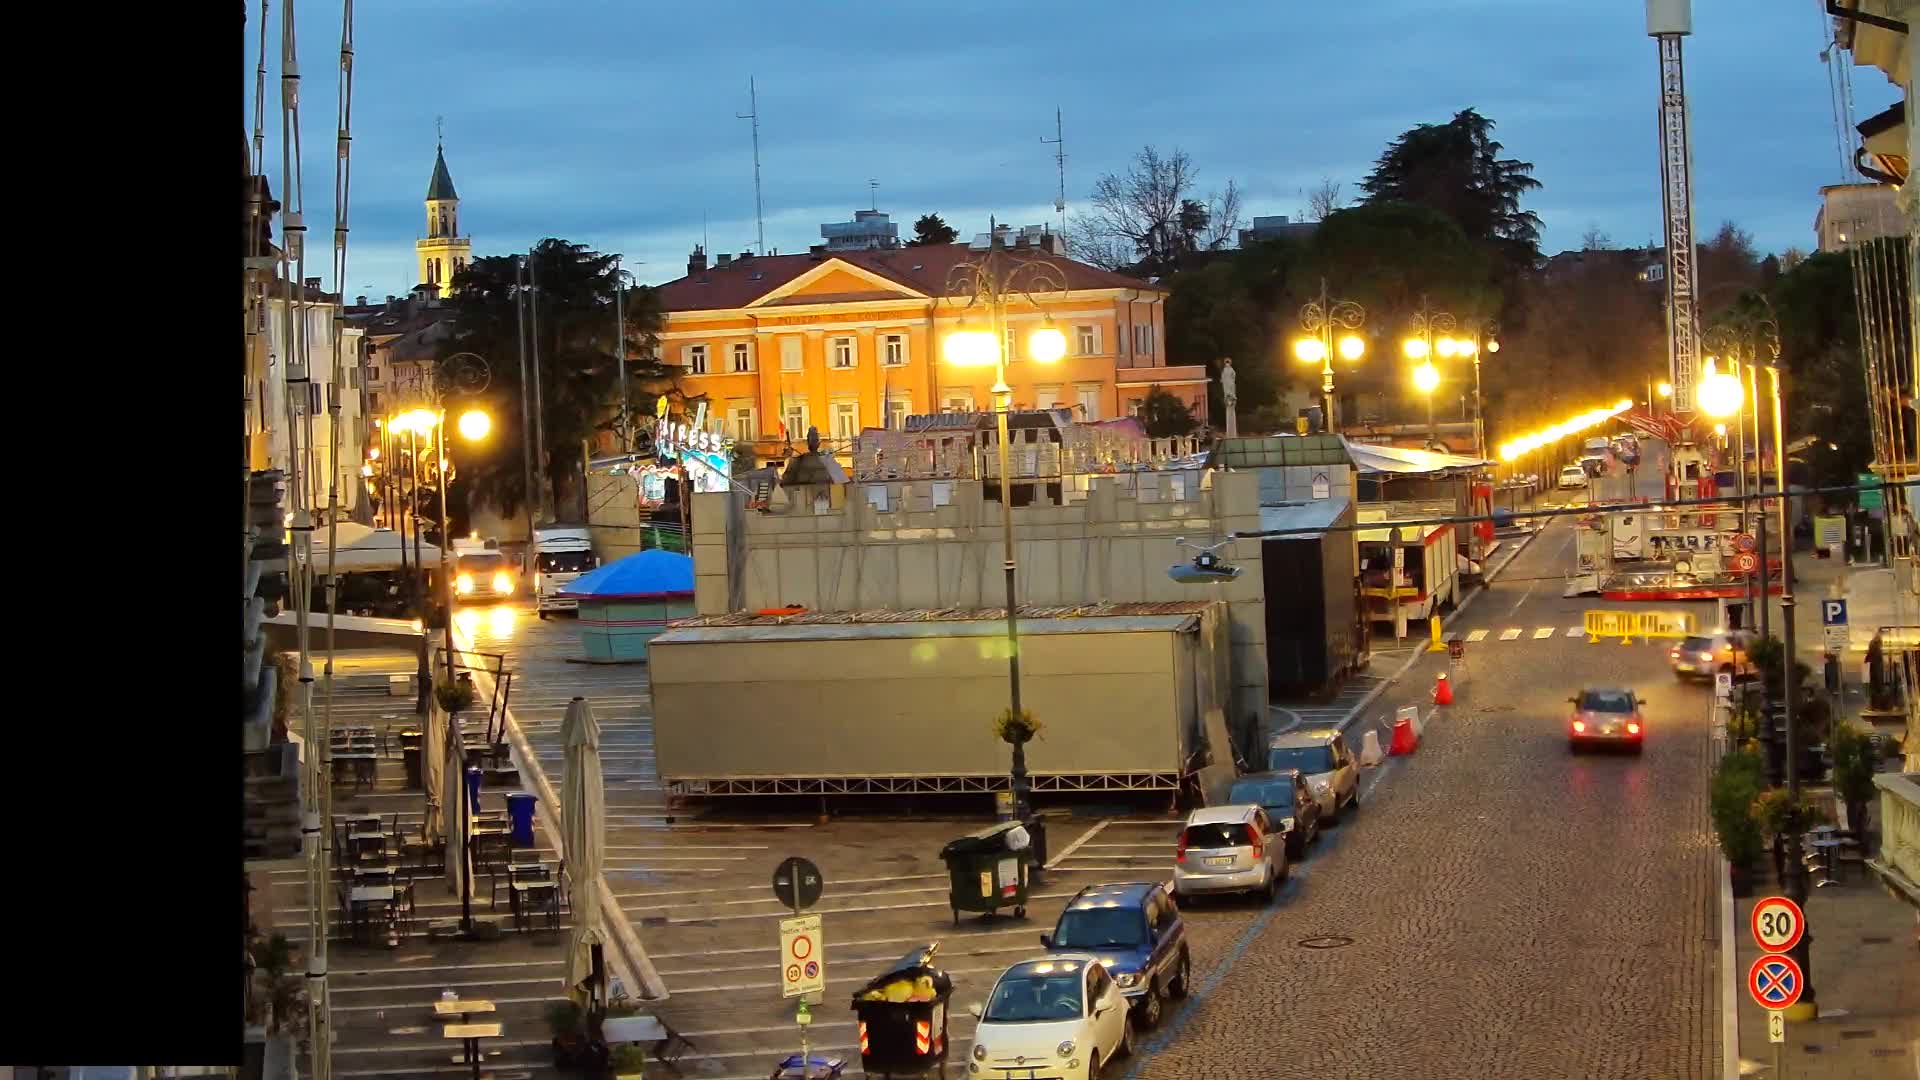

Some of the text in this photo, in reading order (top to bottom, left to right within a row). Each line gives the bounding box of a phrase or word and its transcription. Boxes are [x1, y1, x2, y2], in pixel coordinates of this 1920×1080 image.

[1742, 558, 1752, 567] 20
[1827, 602, 1841, 621] P
[1761, 912, 1791, 937] 30
